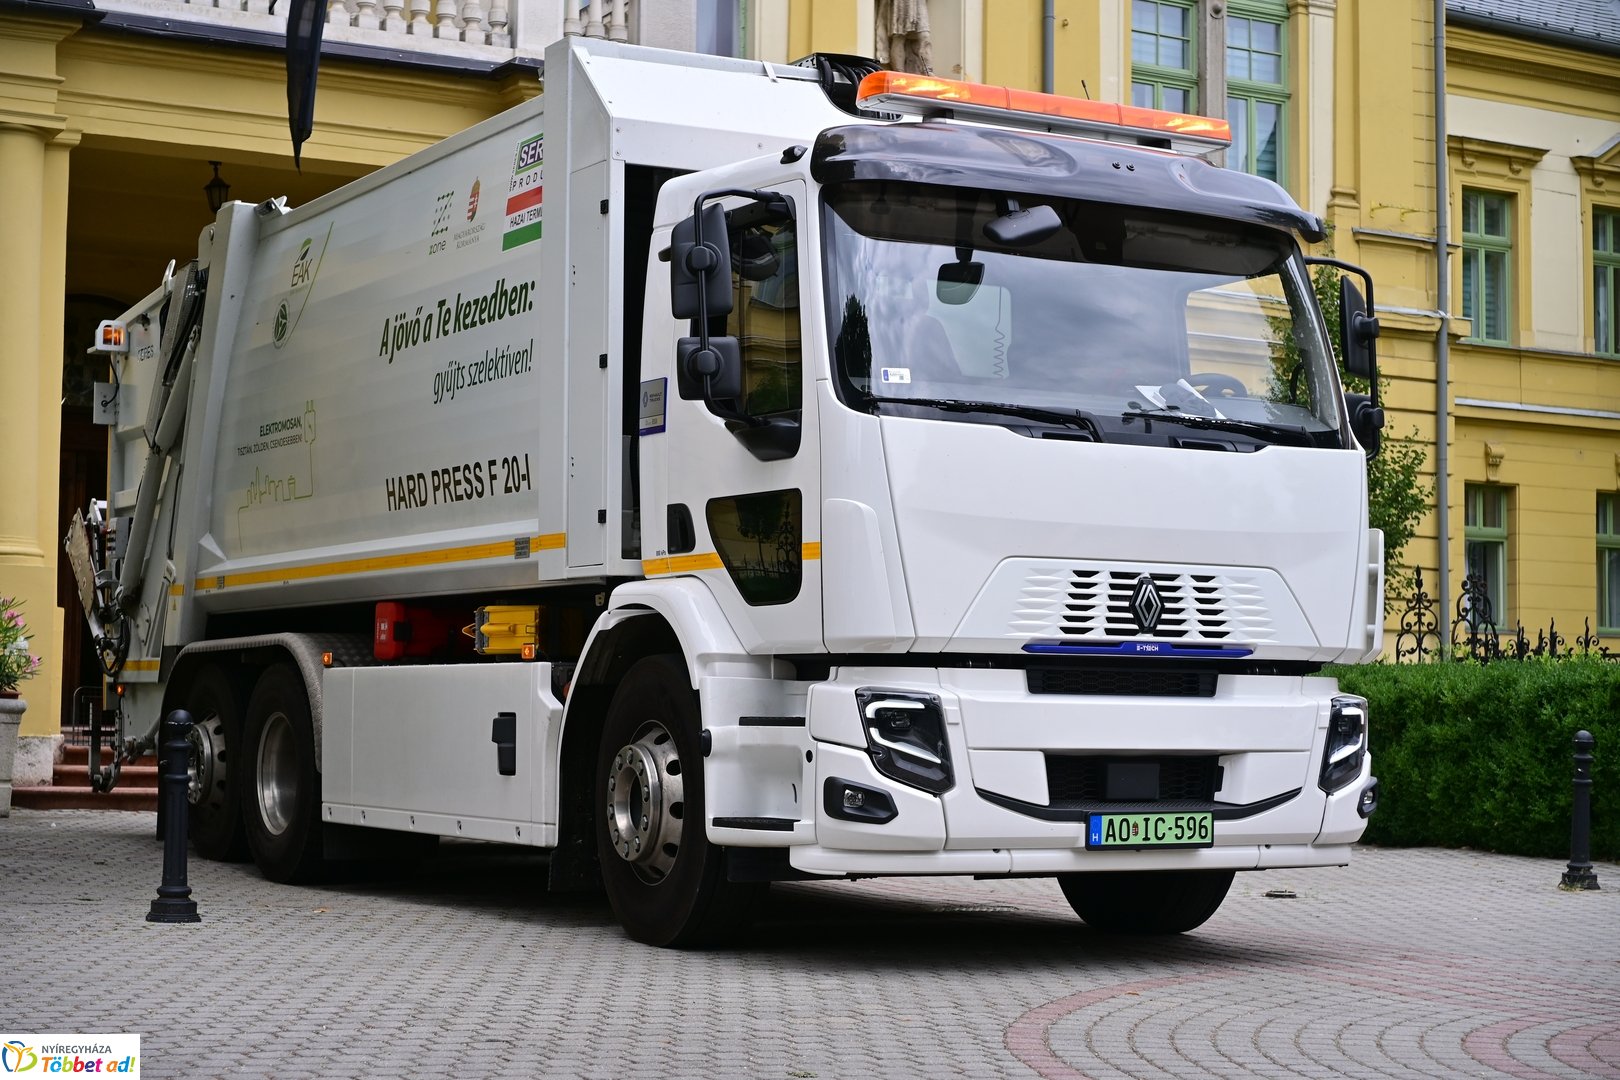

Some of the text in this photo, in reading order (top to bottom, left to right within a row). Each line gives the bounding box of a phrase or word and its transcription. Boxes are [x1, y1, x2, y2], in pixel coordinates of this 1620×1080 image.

[526, 206, 543, 222] TERM
[379, 278, 536, 364] A jövő a Te kezedben:
[433, 338, 534, 405] gyűjts szelektíven!
[385, 453, 531, 512] HARD PRESS F 20-I
[1092, 833, 1099, 842] H
